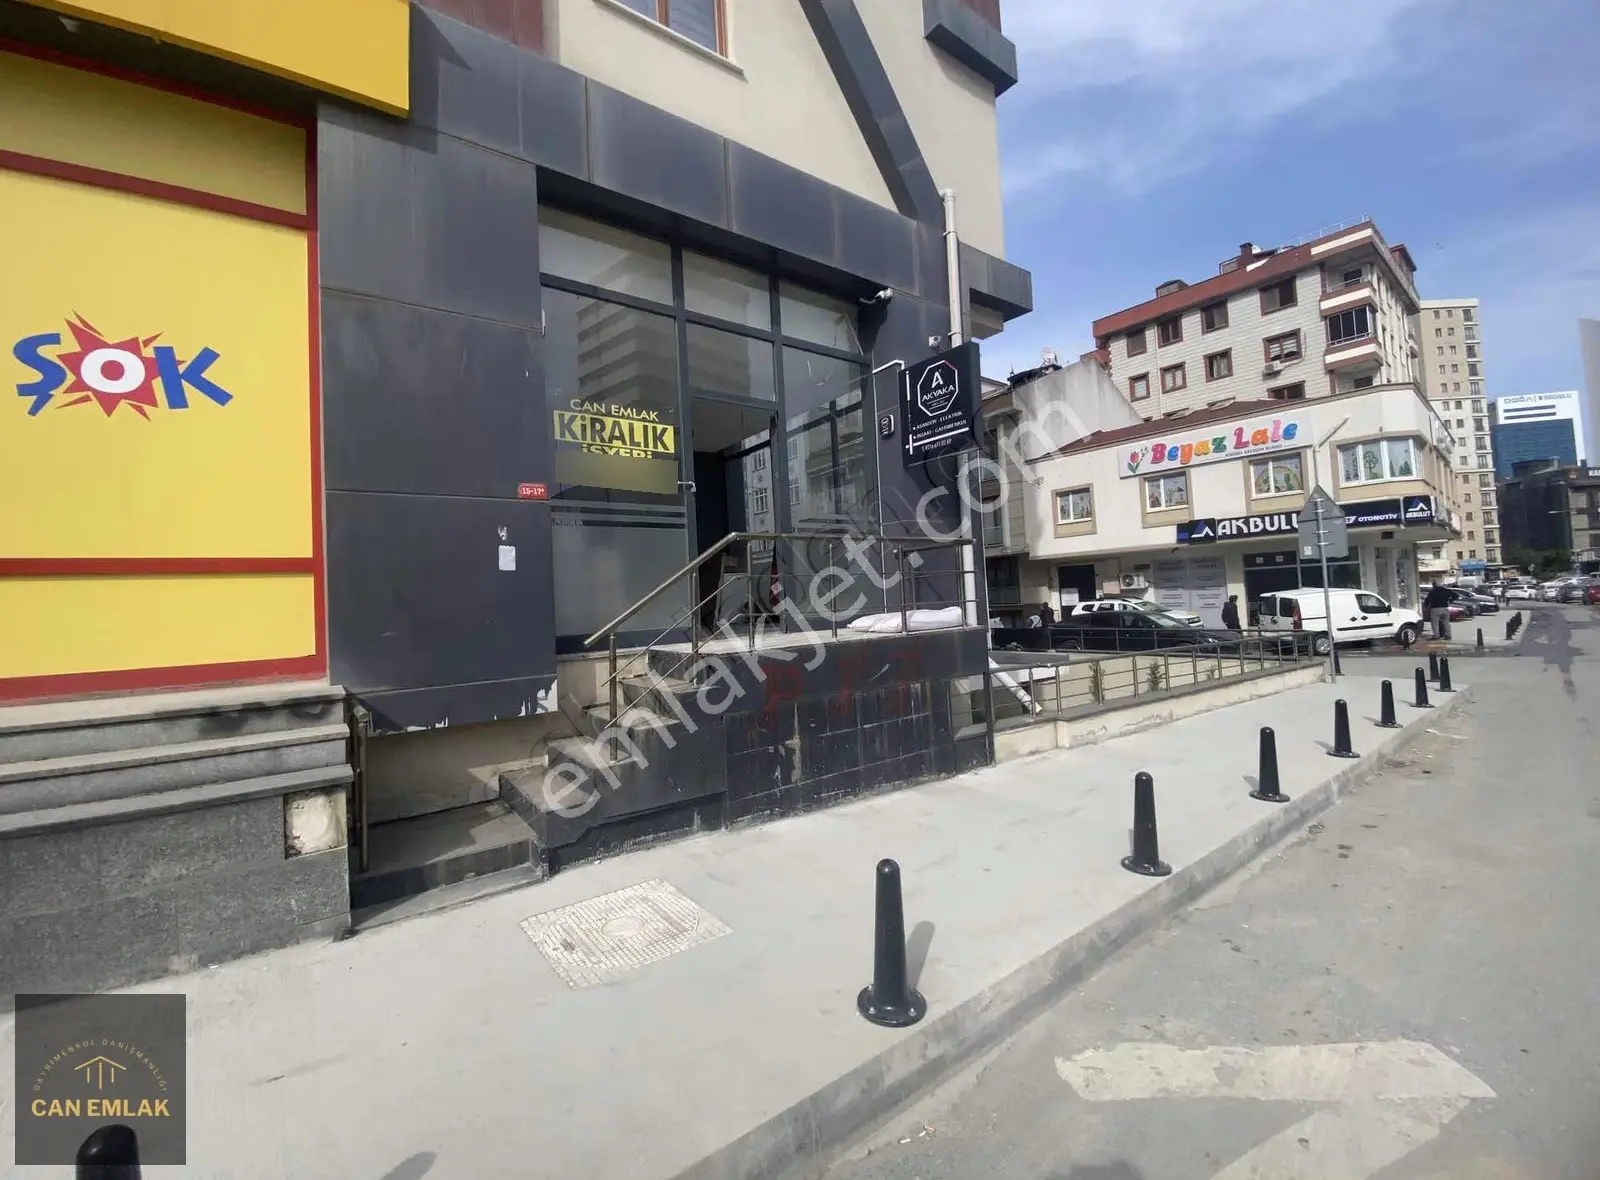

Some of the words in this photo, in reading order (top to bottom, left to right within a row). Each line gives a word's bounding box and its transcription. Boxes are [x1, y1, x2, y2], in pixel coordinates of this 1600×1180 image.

[13, 332, 234, 417] ŞOK
[570, 399, 606, 414] CAN
[611, 404, 659, 421] EMLAK
[921, 384, 955, 402] AKYAKA
[1150, 435, 1228, 465] Beyaz
[1233, 418, 1298, 450] Lale
